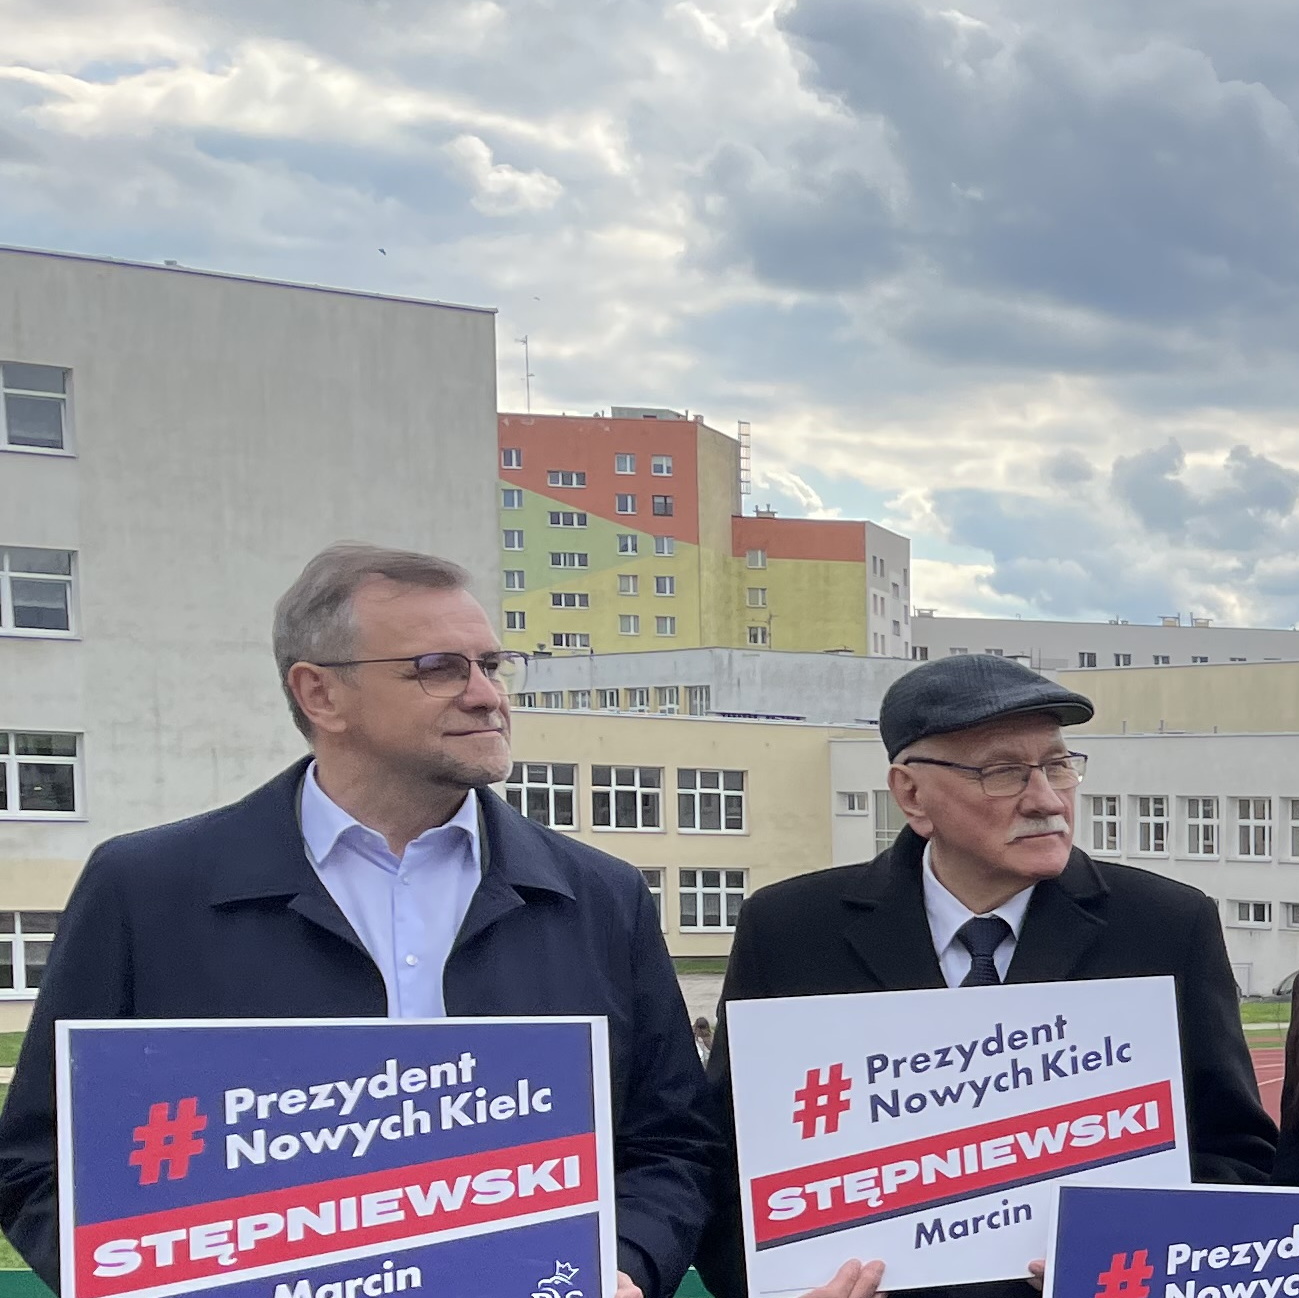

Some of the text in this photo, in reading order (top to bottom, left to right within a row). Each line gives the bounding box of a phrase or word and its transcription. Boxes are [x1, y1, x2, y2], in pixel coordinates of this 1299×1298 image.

[224, 1051, 476, 1125] Prezydent
[867, 1015, 1066, 1084] Prezydent
[869, 1035, 1132, 1124] Nowych Kielc
[129, 1097, 207, 1185] #
[225, 1078, 552, 1170] Nowych Kielc
[793, 1063, 852, 1139] #
[767, 1098, 1160, 1221] STĘPNIEWSKI
[92, 1154, 581, 1281] STĘPNIEWSKI
[914, 1198, 1033, 1250] Marcin
